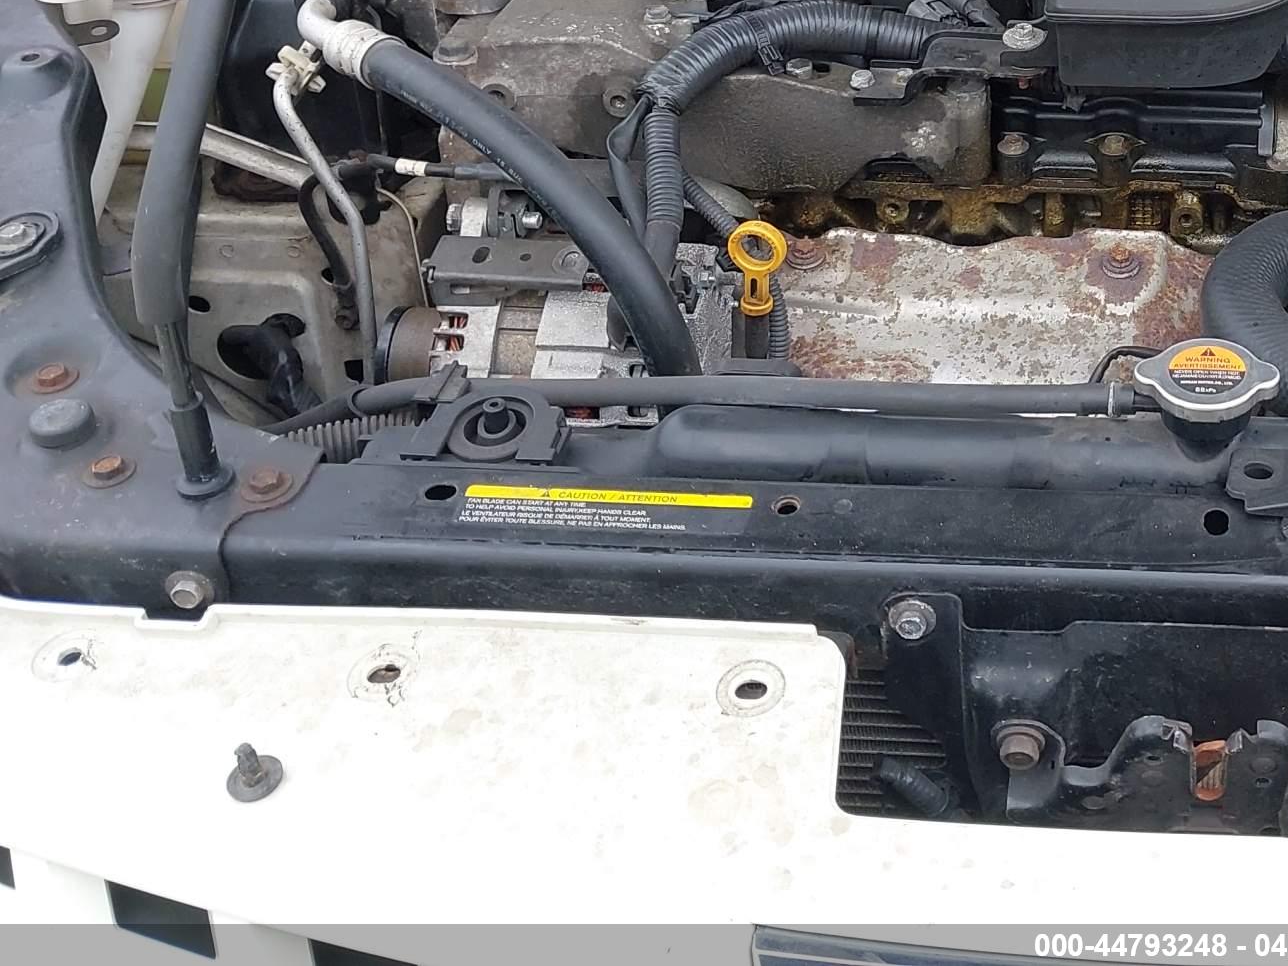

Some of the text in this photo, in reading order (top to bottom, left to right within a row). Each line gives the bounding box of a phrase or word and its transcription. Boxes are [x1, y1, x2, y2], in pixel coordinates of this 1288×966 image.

[1185, 356, 1231, 364] WARNING
[558, 491, 607, 501] CAUTION
[617, 494, 678, 504] ATTENTION
[517, 505, 554, 513] PERSONAL
[471, 510, 516, 518] VENTILATEUR
